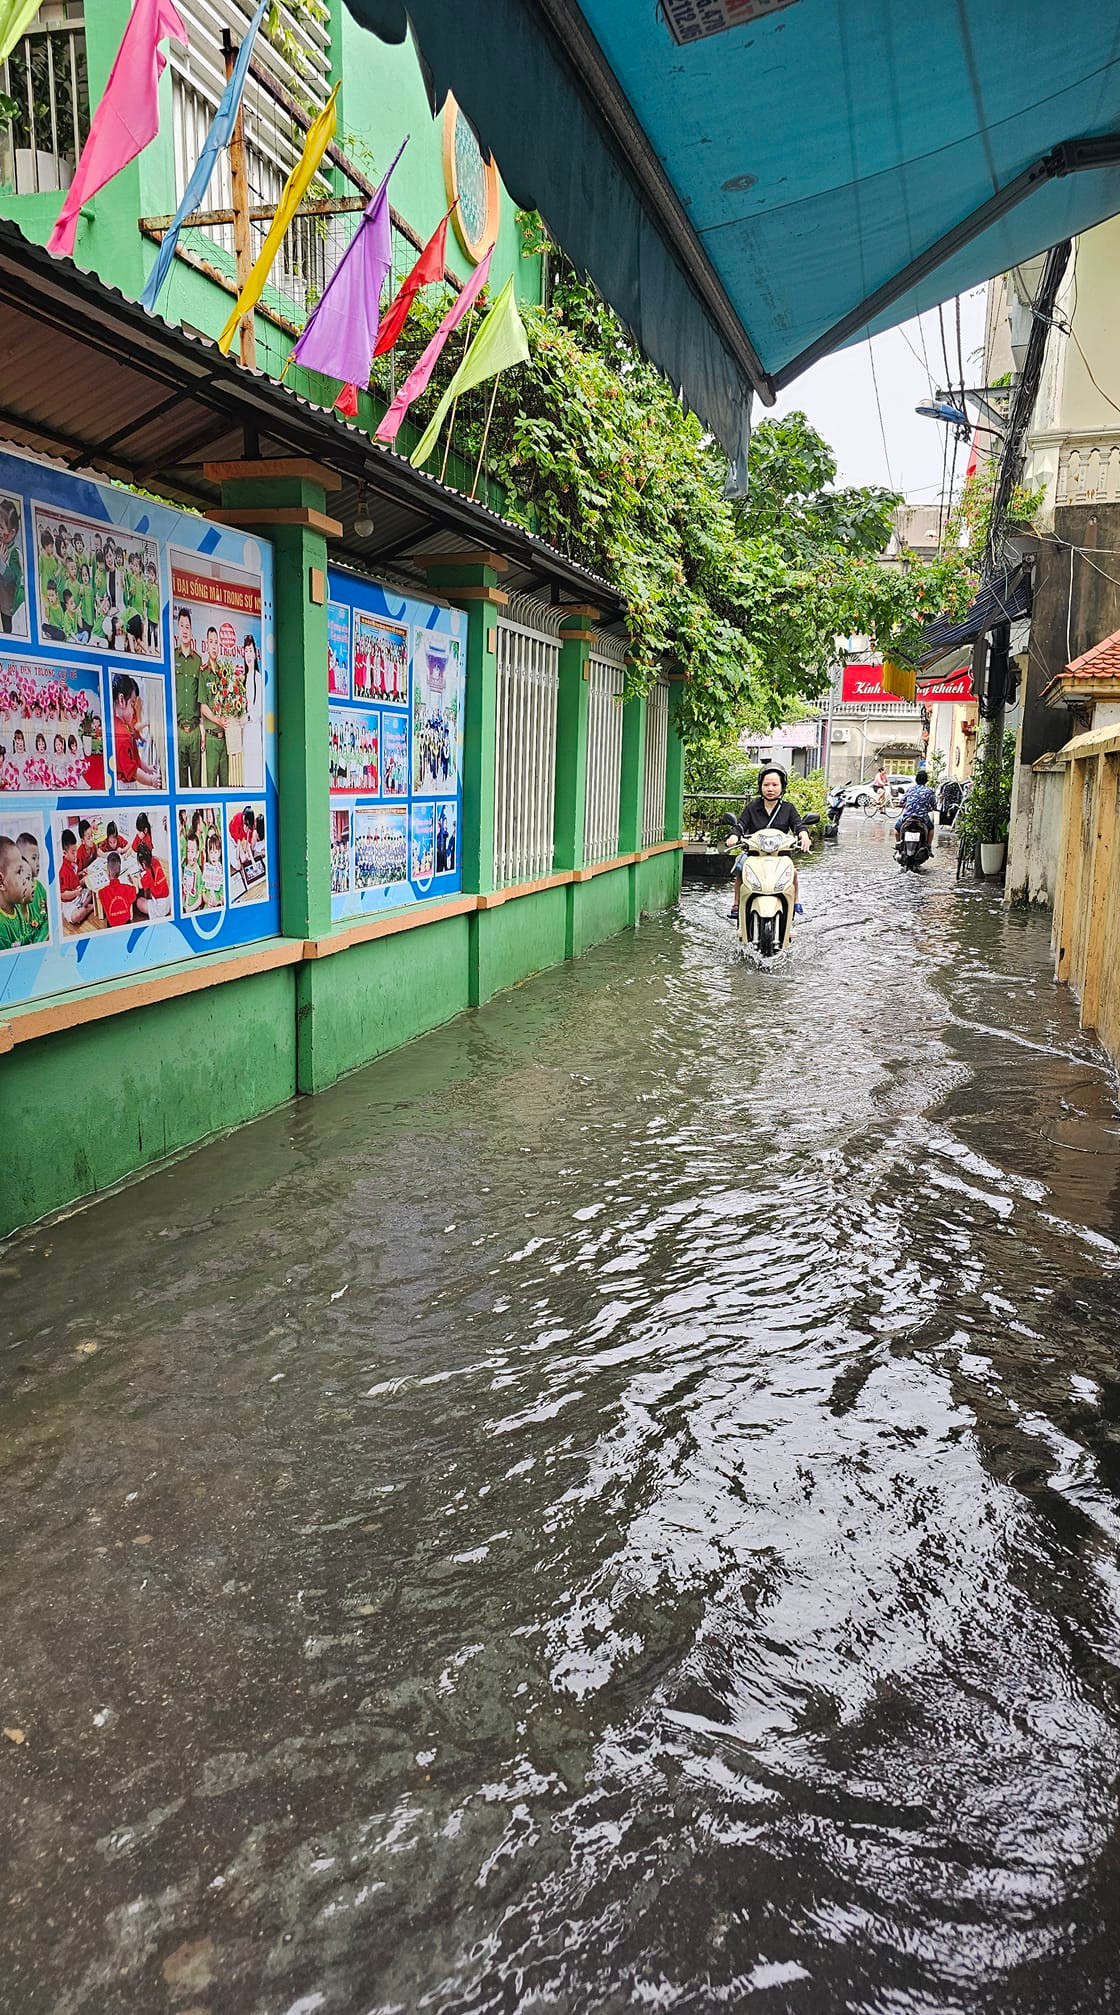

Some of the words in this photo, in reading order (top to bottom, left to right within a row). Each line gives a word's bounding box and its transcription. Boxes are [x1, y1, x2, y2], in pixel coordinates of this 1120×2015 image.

[190, 577, 208, 599] SỐNG
[223, 589, 244, 609] TRONG
[244, 594, 253, 611] SỰ
[852, 682, 880, 694] Kính
[932, 681, 964, 694] khách
